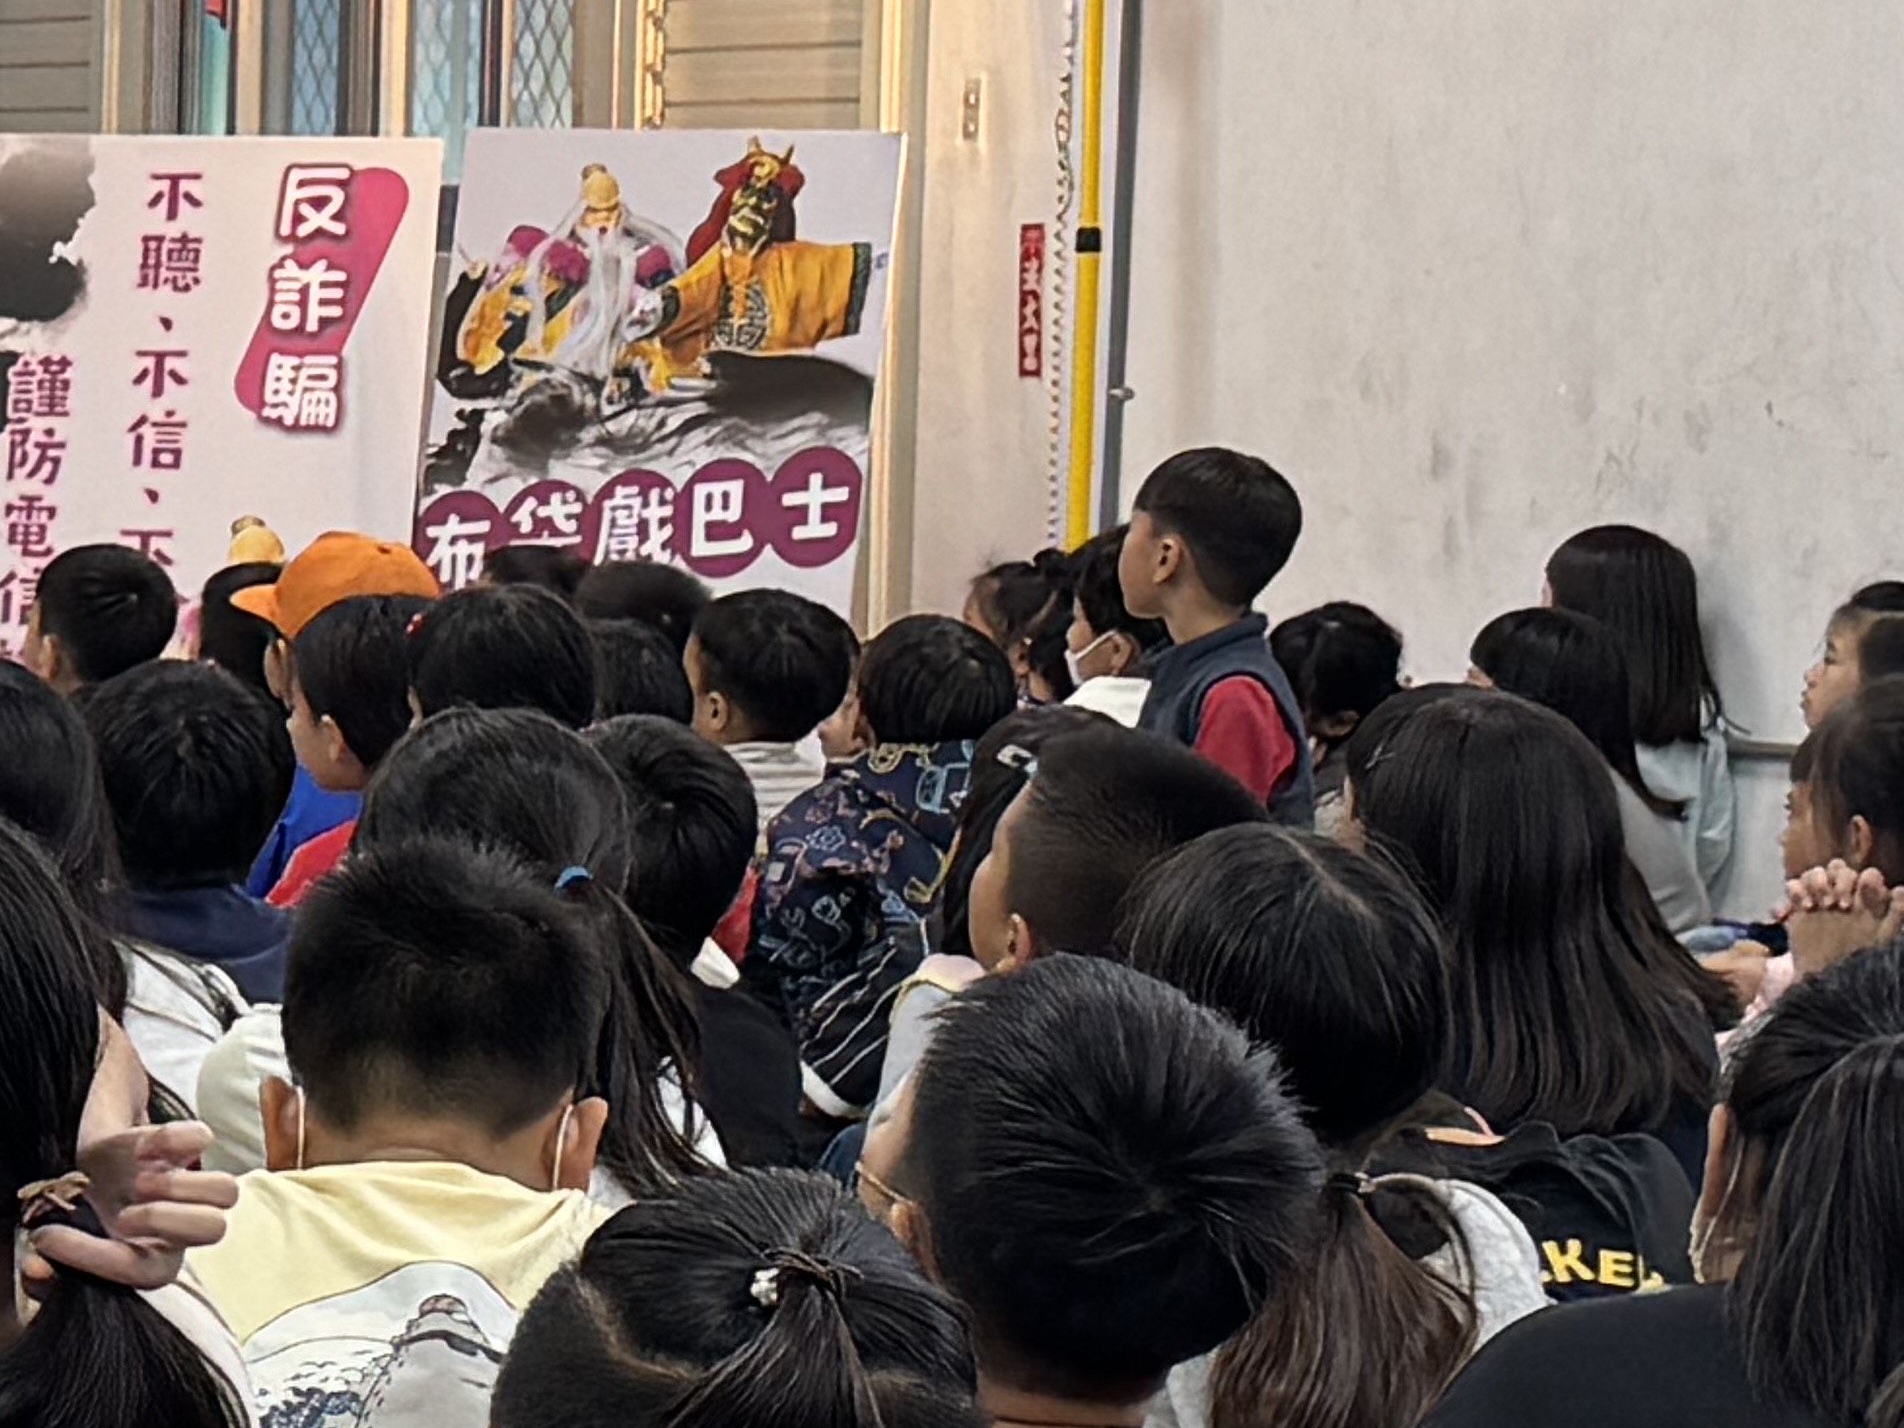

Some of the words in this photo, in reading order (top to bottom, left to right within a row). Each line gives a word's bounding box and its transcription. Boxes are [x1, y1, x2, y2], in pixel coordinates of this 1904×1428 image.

[261, 163, 352, 430] 反詐騙
[425, 472, 850, 589] 布袋戲巴士
